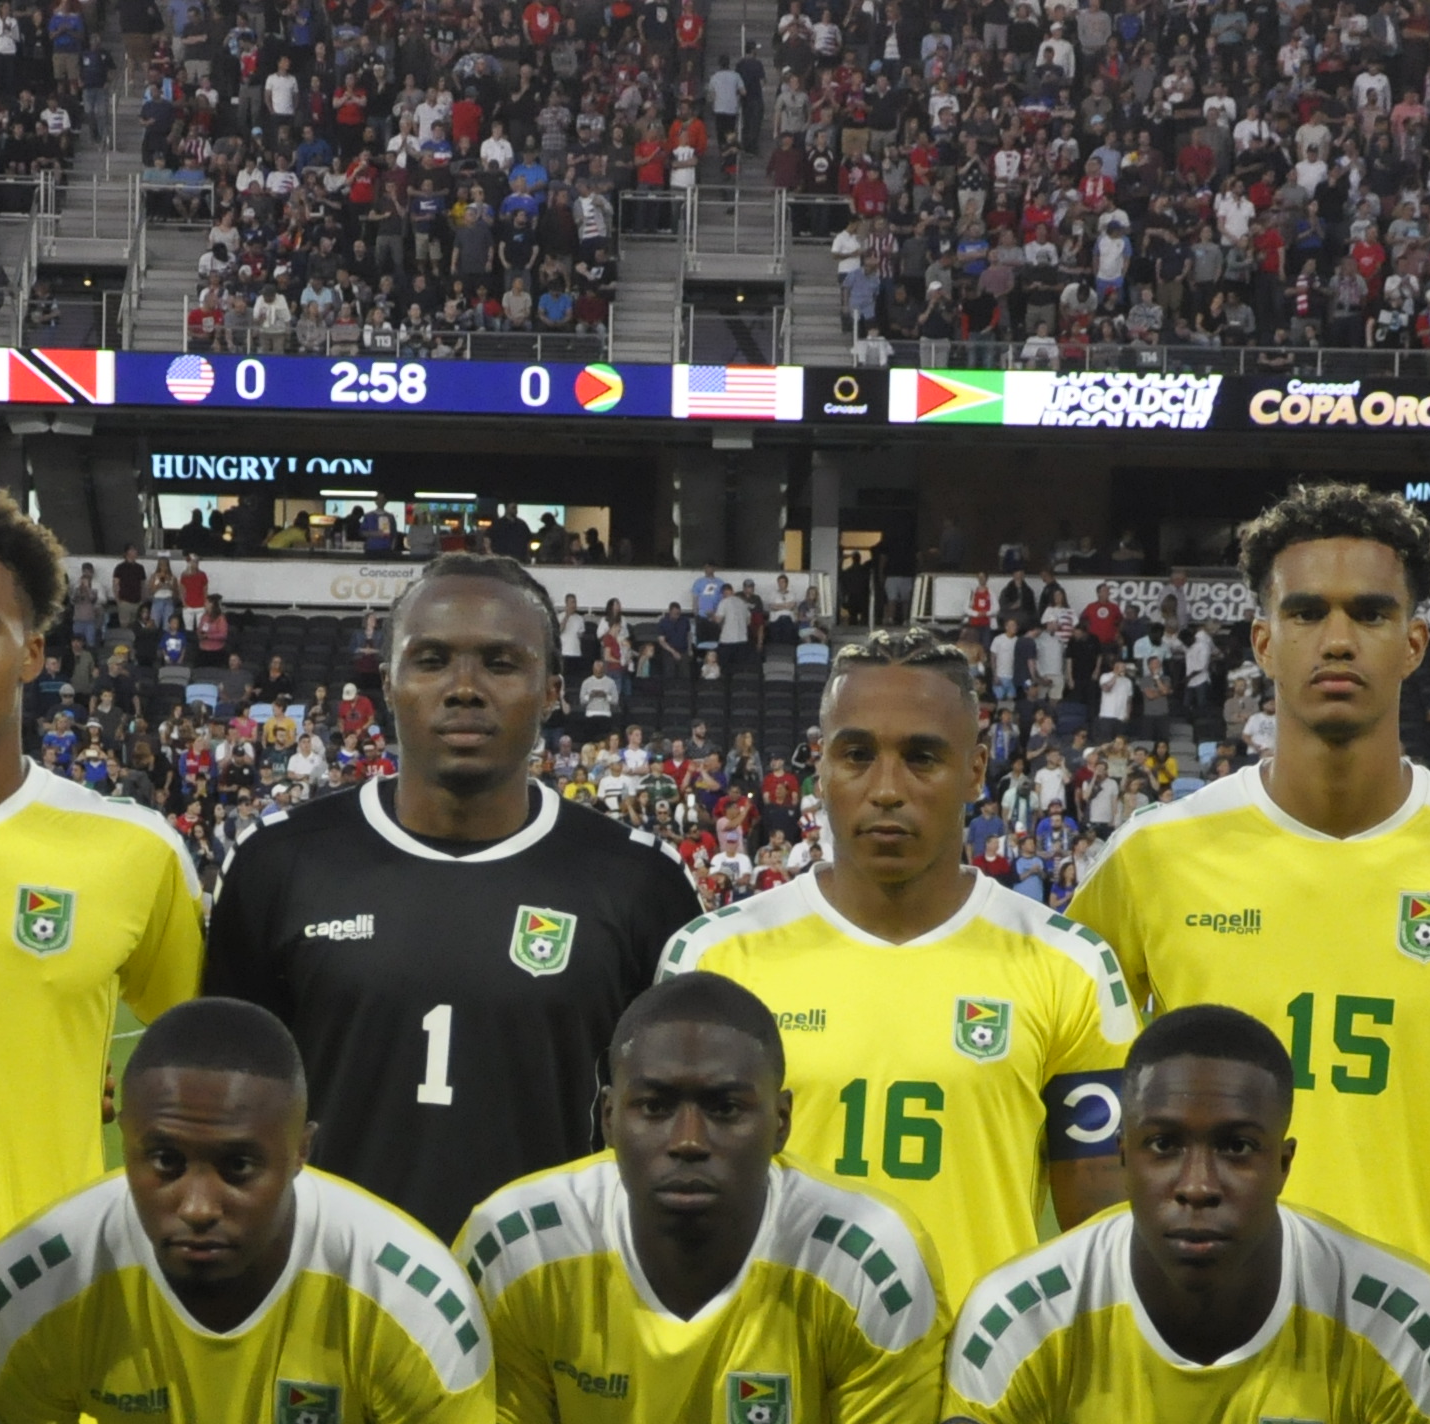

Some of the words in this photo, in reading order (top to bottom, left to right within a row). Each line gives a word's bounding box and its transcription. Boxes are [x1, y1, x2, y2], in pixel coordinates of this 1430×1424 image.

[374, 334, 392, 348] 113
[234, 358, 266, 400] 0
[329, 360, 428, 404] 2:58
[519, 365, 551, 407] 0
[1249, 389, 1358, 425] COPA
[151, 453, 280, 481] HUNGRY
[359, 566, 415, 579] Concacaf
[304, 914, 375, 940] capelli
[1185, 908, 1262, 934] capelli
[772, 1008, 827, 1032] pelli
[417, 1003, 453, 1106] 1
[1286, 991, 1396, 1097] 15
[834, 1077, 946, 1181] 16
